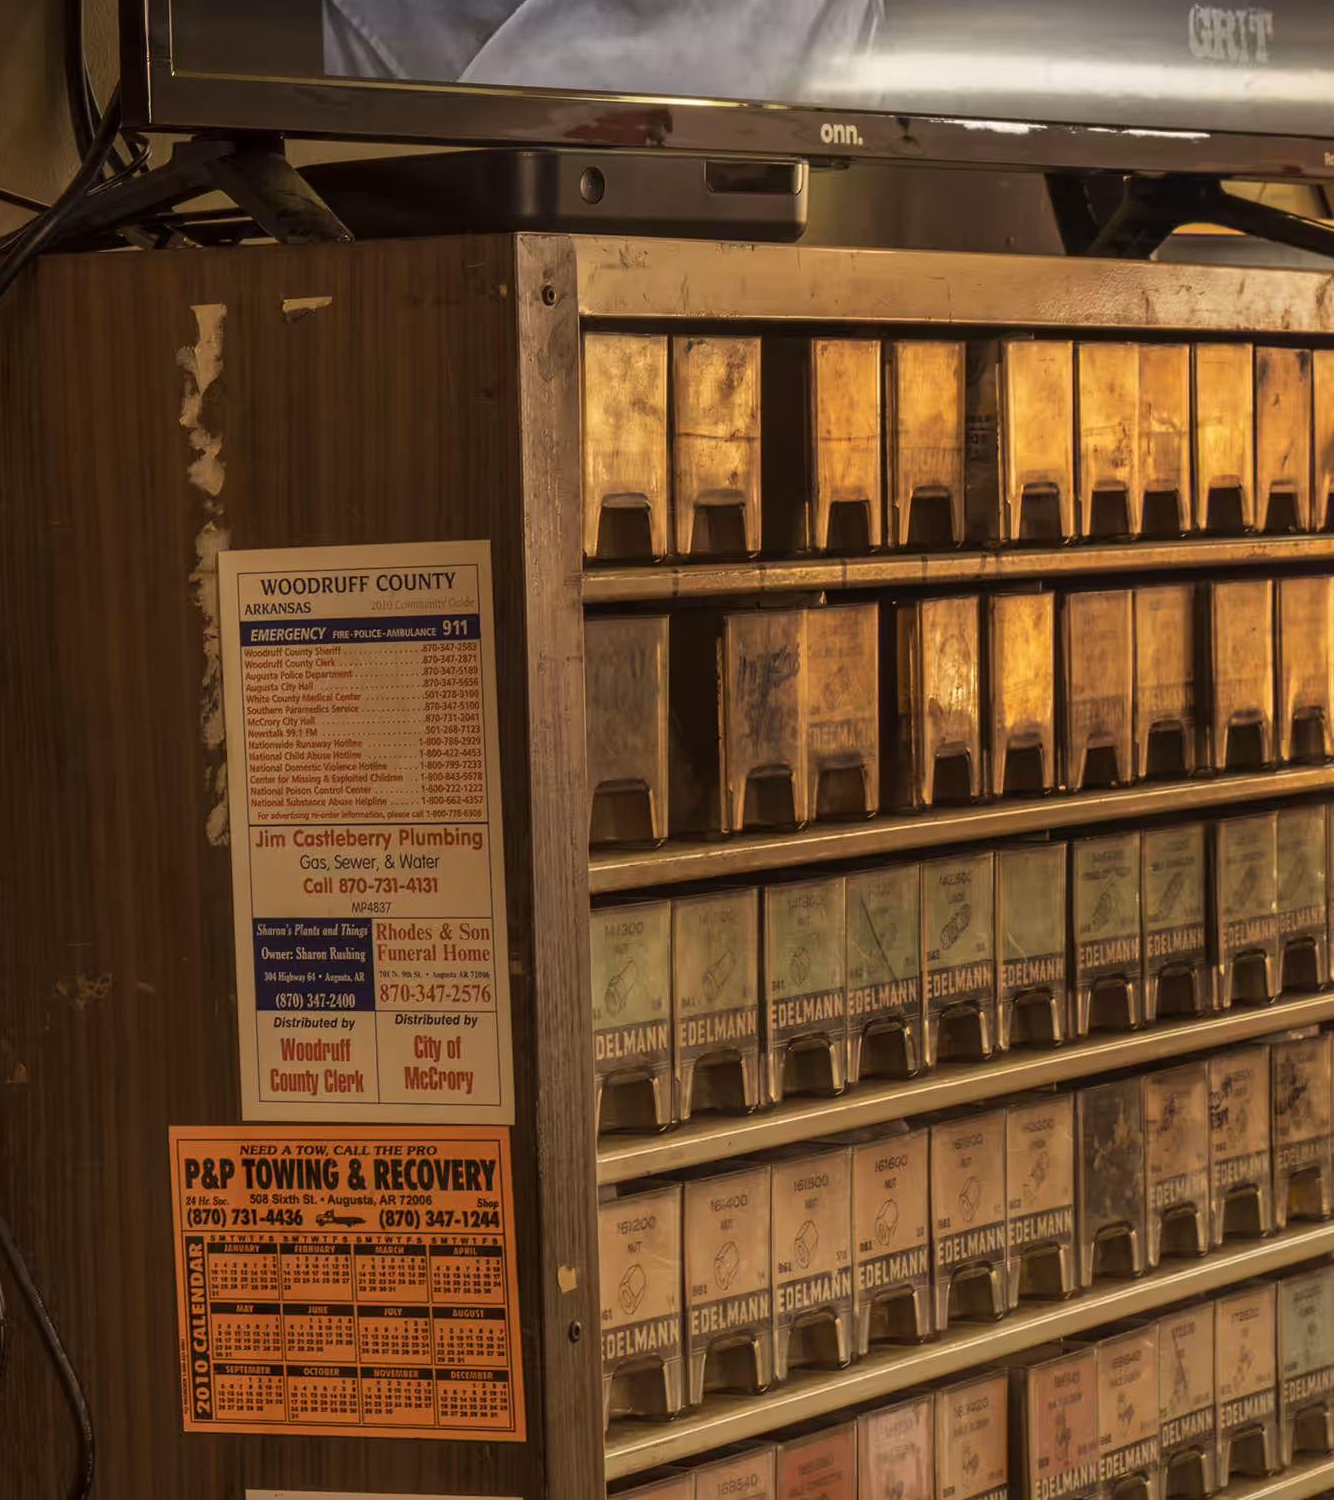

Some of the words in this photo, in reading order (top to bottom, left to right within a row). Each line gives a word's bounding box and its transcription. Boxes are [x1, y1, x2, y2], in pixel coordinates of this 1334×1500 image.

[1188, 3, 1273, 63] GRIT
[820, 122, 865, 147] onn.
[261, 576, 369, 596] WOODRUFF
[377, 572, 456, 592] COUNTY
[245, 602, 311, 616] ARKANSAS
[251, 627, 325, 642] EMERGENCY
[443, 620, 468, 636] 911
[244, 648, 282, 658] Woodruff
[285, 648, 312, 658] County
[256, 831, 285, 848] Jim
[293, 830, 392, 850] Castleberry
[399, 830, 483, 850] Plumbing
[299, 855, 331, 871] Gas,
[334, 855, 379, 871] Sewer,
[385, 856, 395, 870] &
[399, 855, 440, 870] Water
[303, 878, 333, 894] Call
[339, 878, 438, 894] 870-731-4131
[351, 902, 391, 913] MP4837
[295, 924, 319, 936] Plants
[322, 924, 339, 936] and
[341, 924, 368, 936] Things
[376, 924, 432, 940] Rhodes
[439, 924, 453, 940] &
[459, 923, 490, 940] Son
[261, 948, 293, 961] Owner:
[296, 948, 327, 960] Sharon
[329, 948, 366, 963] Rushing
[377, 945, 437, 962] Funeral
[443, 944, 490, 962] Home
[355, 972, 365, 982] AR
[927, 964, 991, 998] EDELMANN
[1002, 958, 1064, 987] EDELMANN
[275, 994, 303, 1010] (870)
[307, 994, 355, 1008] 347-2400
[380, 984, 491, 1003] 870-347-2576
[847, 978, 919, 1016] EDELMANN
[771, 994, 843, 1028] EDELMANN
[273, 1018, 338, 1029] Distributed
[342, 1018, 355, 1031] by
[395, 1014, 461, 1026] Distributed
[464, 1015, 477, 1028] by
[680, 1011, 757, 1047] EDELMANN
[281, 1038, 351, 1062] Woodruff
[413, 1036, 442, 1062] City
[447, 1036, 461, 1059] of
[270, 1068, 319, 1096] County
[325, 1069, 364, 1093] Clerk
[405, 1067, 473, 1094] McCrory
[239, 1145, 277, 1156] NEED
[281, 1146, 292, 1156] A
[296, 1146, 329, 1157] TOW,
[334, 1146, 370, 1156] CALL
[375, 1146, 403, 1156] THE
[406, 1146, 437, 1156] PRO
[185, 1159, 235, 1189] P&P
[242, 1159, 339, 1190] TOWING
[348, 1159, 366, 1189] &
[375, 1159, 496, 1191] RECOVERY
[250, 1194, 269, 1205] 508
[272, 1194, 301, 1205] Sixth
[305, 1194, 318, 1205] St.
[328, 1195, 376, 1208] Augusta,
[379, 1195, 396, 1206] AR
[399, 1195, 432, 1206] 72006
[477, 1198, 498, 1209] Shop
[187, 1209, 226, 1227] (870)
[231, 1209, 303, 1226] 731-4436
[379, 1210, 420, 1229] (870)
[426, 1211, 500, 1229] 347-1244
[1009, 1211, 1072, 1245] EDELMANN
[224, 1244, 259, 1253] JANUARY
[627, 1241, 641, 1253] NUT
[937, 1226, 1004, 1265] EDELMANN
[858, 1250, 928, 1289] EDELMANN
[779, 1270, 852, 1312] EDELMANN
[188, 1243, 208, 1359] CALENDAR
[692, 1294, 769, 1336] EDELMANN
[303, 1368, 339, 1377] OCTOBER
[373, 1369, 419, 1379] NOVEMBER
[451, 1371, 493, 1381] DECEMBER
[195, 1360, 211, 1415] 2010
[1221, 1390, 1275, 1428] EDELMANN
[1100, 1440, 1160, 1481] EDELMANN
